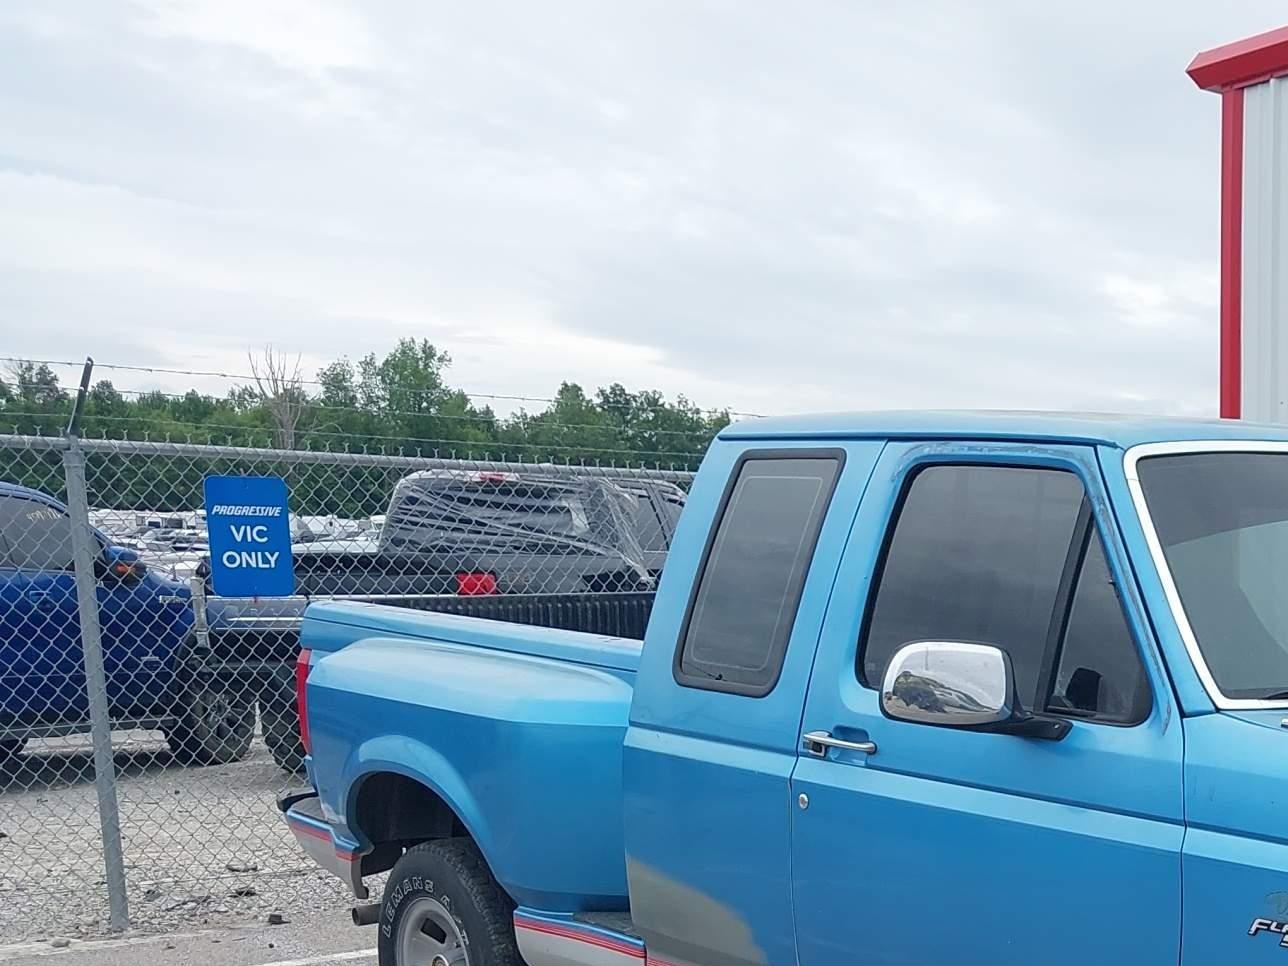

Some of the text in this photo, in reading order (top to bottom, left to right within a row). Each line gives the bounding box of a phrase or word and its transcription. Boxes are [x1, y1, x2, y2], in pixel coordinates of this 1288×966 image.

[212, 505, 282, 517] PROGRESSIVE
[230, 525, 268, 543] VIC
[222, 551, 280, 569] ONLY
[382, 876, 434, 938] LEMANS
